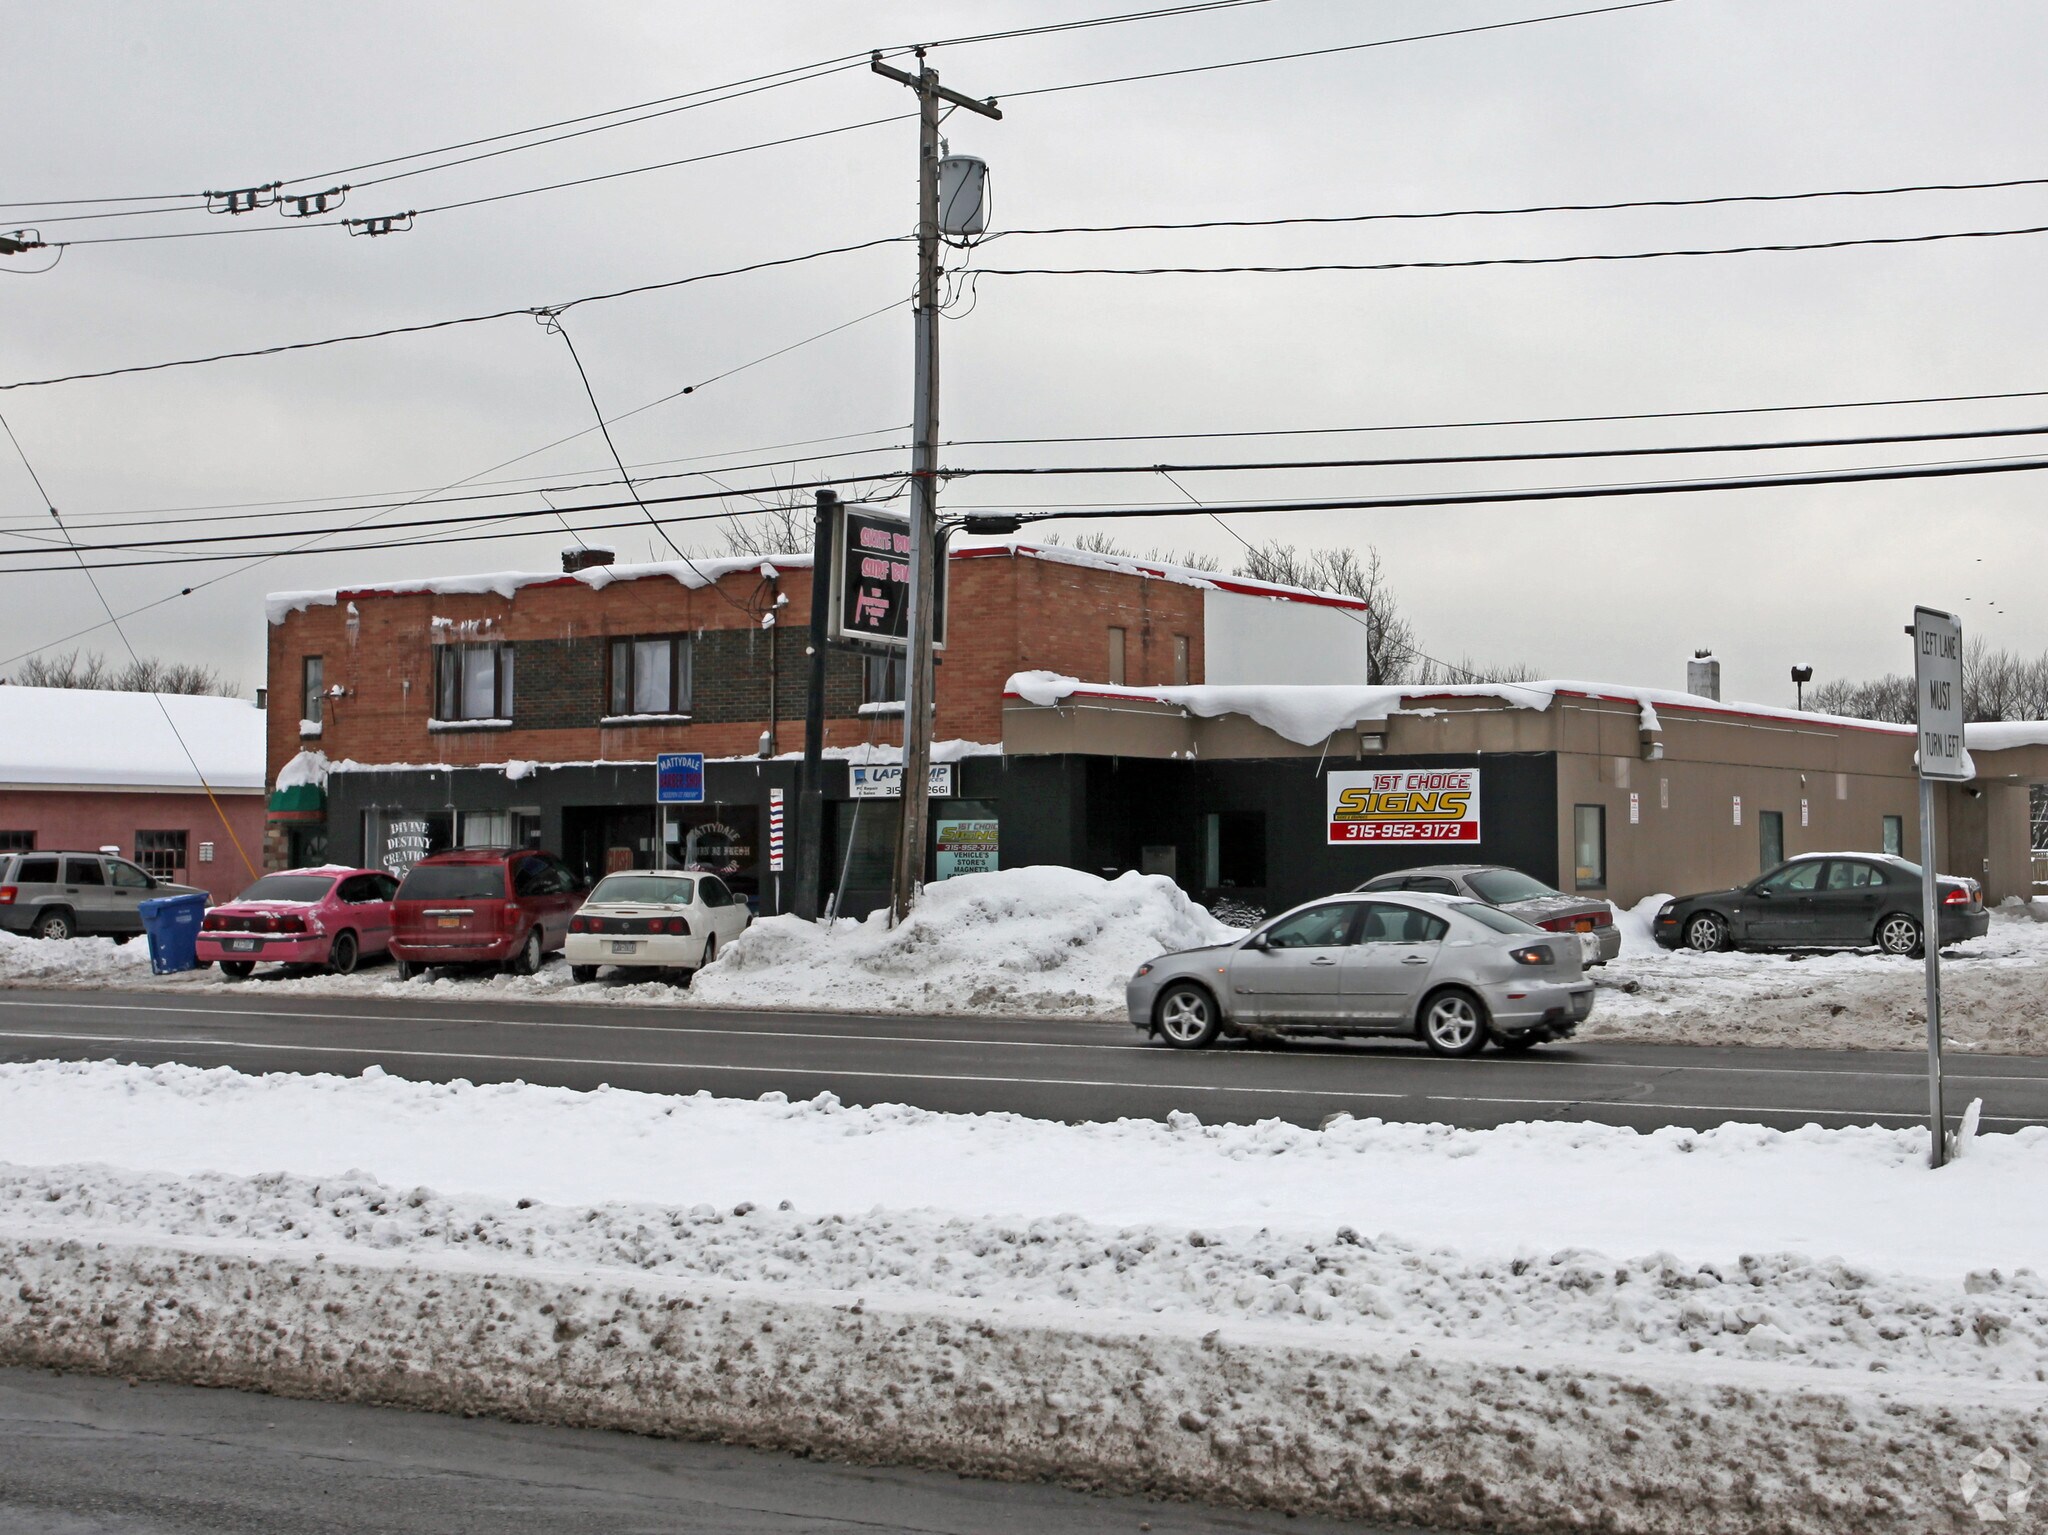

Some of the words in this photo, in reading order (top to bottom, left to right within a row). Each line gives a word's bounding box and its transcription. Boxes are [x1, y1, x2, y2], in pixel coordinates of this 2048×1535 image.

[893, 533, 910, 554] BO
[891, 562, 910, 583] BO
[1921, 631, 1937, 656] LEFT
[1939, 633, 1957, 660] LANE
[1929, 680, 1951, 711] MUST
[1925, 732, 1943, 757] TURN
[1945, 735, 1959, 759] LEFT
[660, 757, 700, 771] MATTYDALE
[1373, 774, 1402, 791] 1ST
[1405, 773, 1472, 791] CHOICE
[1335, 787, 1472, 819] SIGNS
[390, 821, 430, 834] DIVINE
[692, 822, 741, 842] ATTYDALE
[1346, 824, 1461, 838] 315-952-3173
[387, 836, 432, 849] DESTINY
[383, 851, 429, 866] CREATIO
